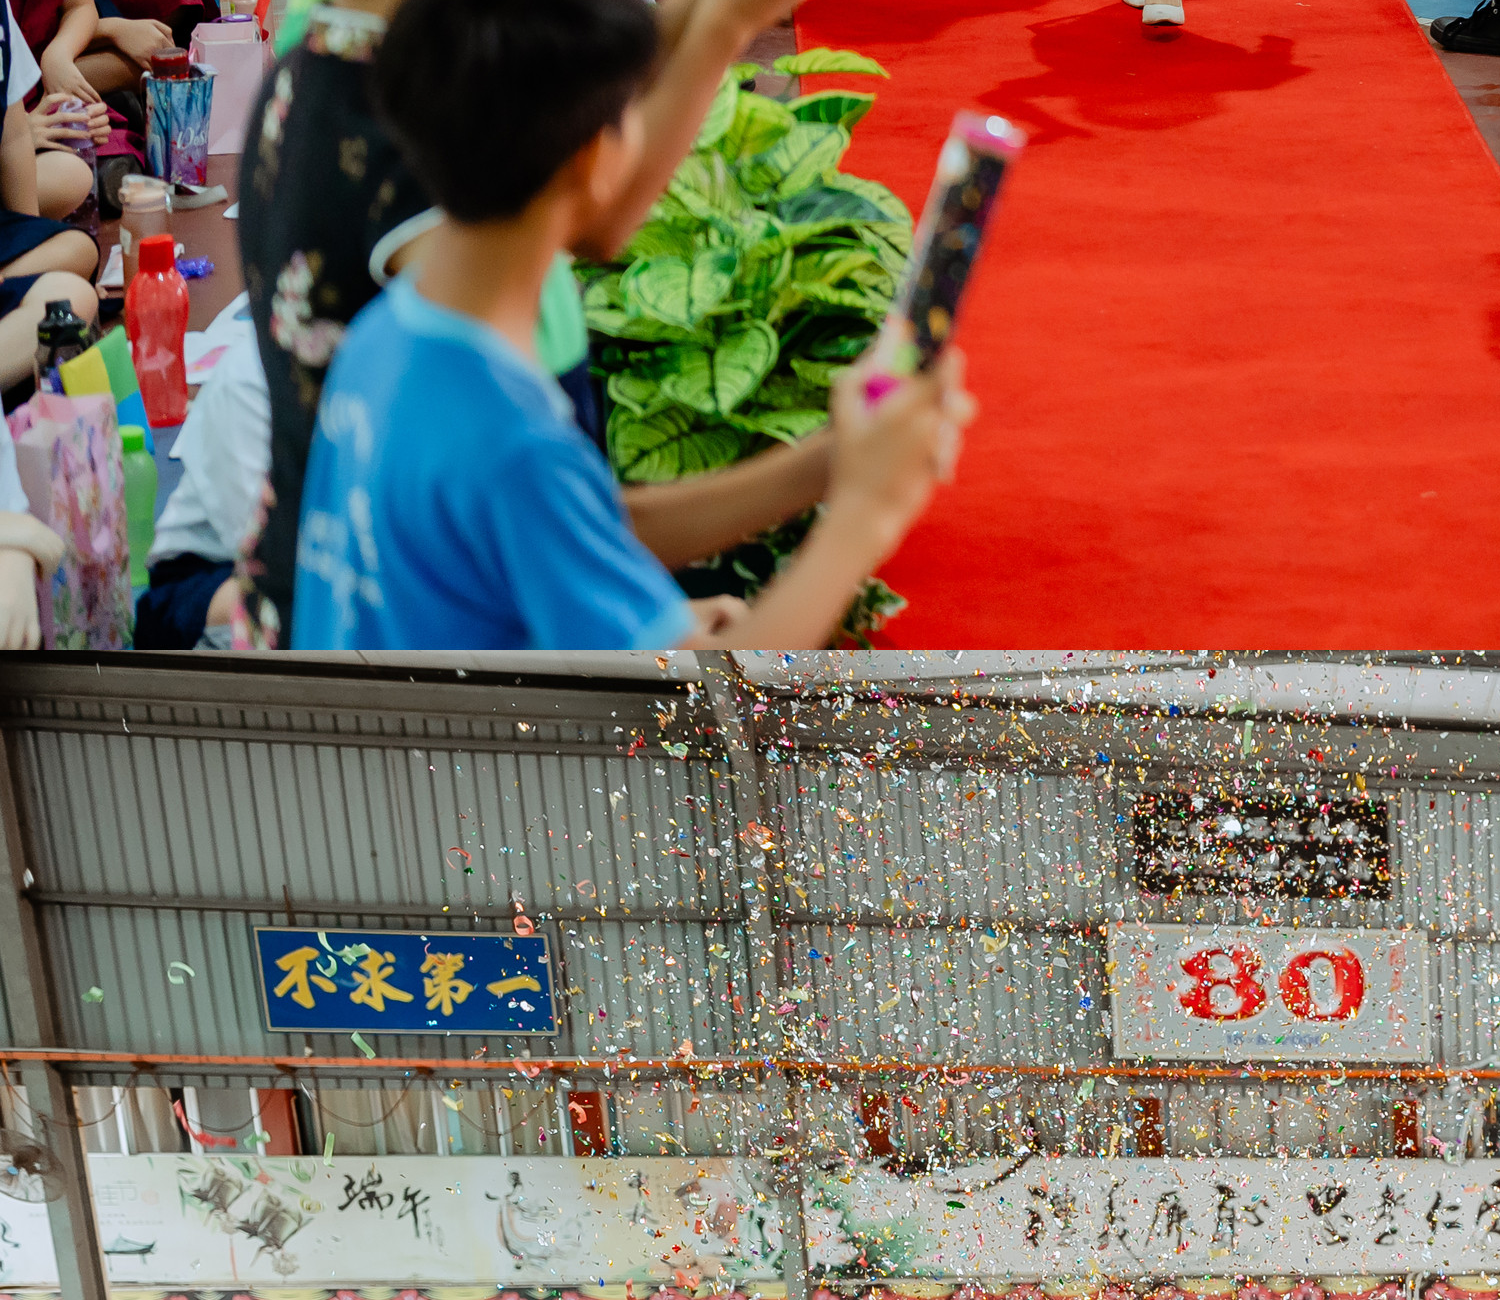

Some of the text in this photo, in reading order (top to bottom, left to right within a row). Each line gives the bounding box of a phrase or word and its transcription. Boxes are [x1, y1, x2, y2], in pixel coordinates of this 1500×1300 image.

[273, 946, 542, 1017] 不求第一
[1178, 945, 1366, 1022] 80
[337, 1169, 431, 1239] 端午
